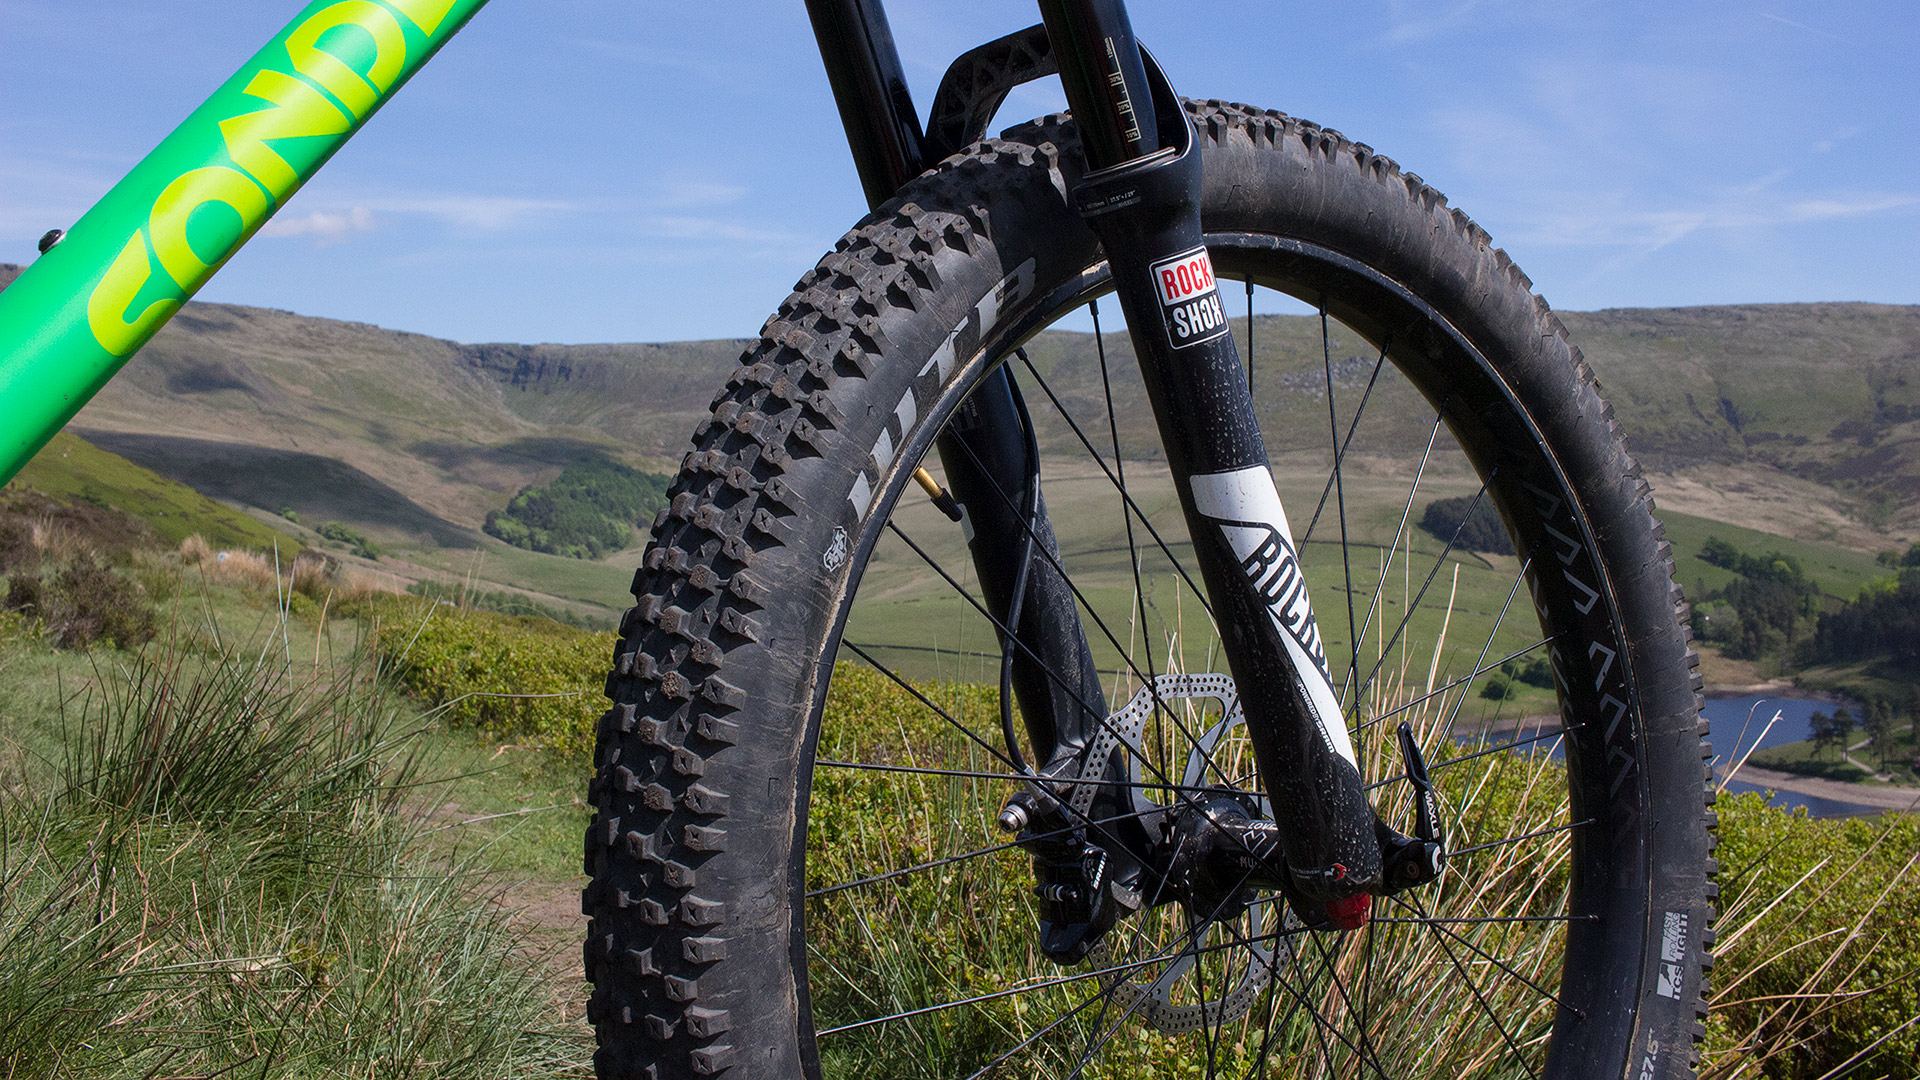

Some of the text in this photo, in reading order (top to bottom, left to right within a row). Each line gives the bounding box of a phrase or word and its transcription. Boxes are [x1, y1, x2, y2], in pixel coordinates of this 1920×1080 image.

[1161, 257, 1213, 300] ROCK
[1172, 294, 1224, 338] SHOX
[1424, 790, 1440, 839] MAXLE
